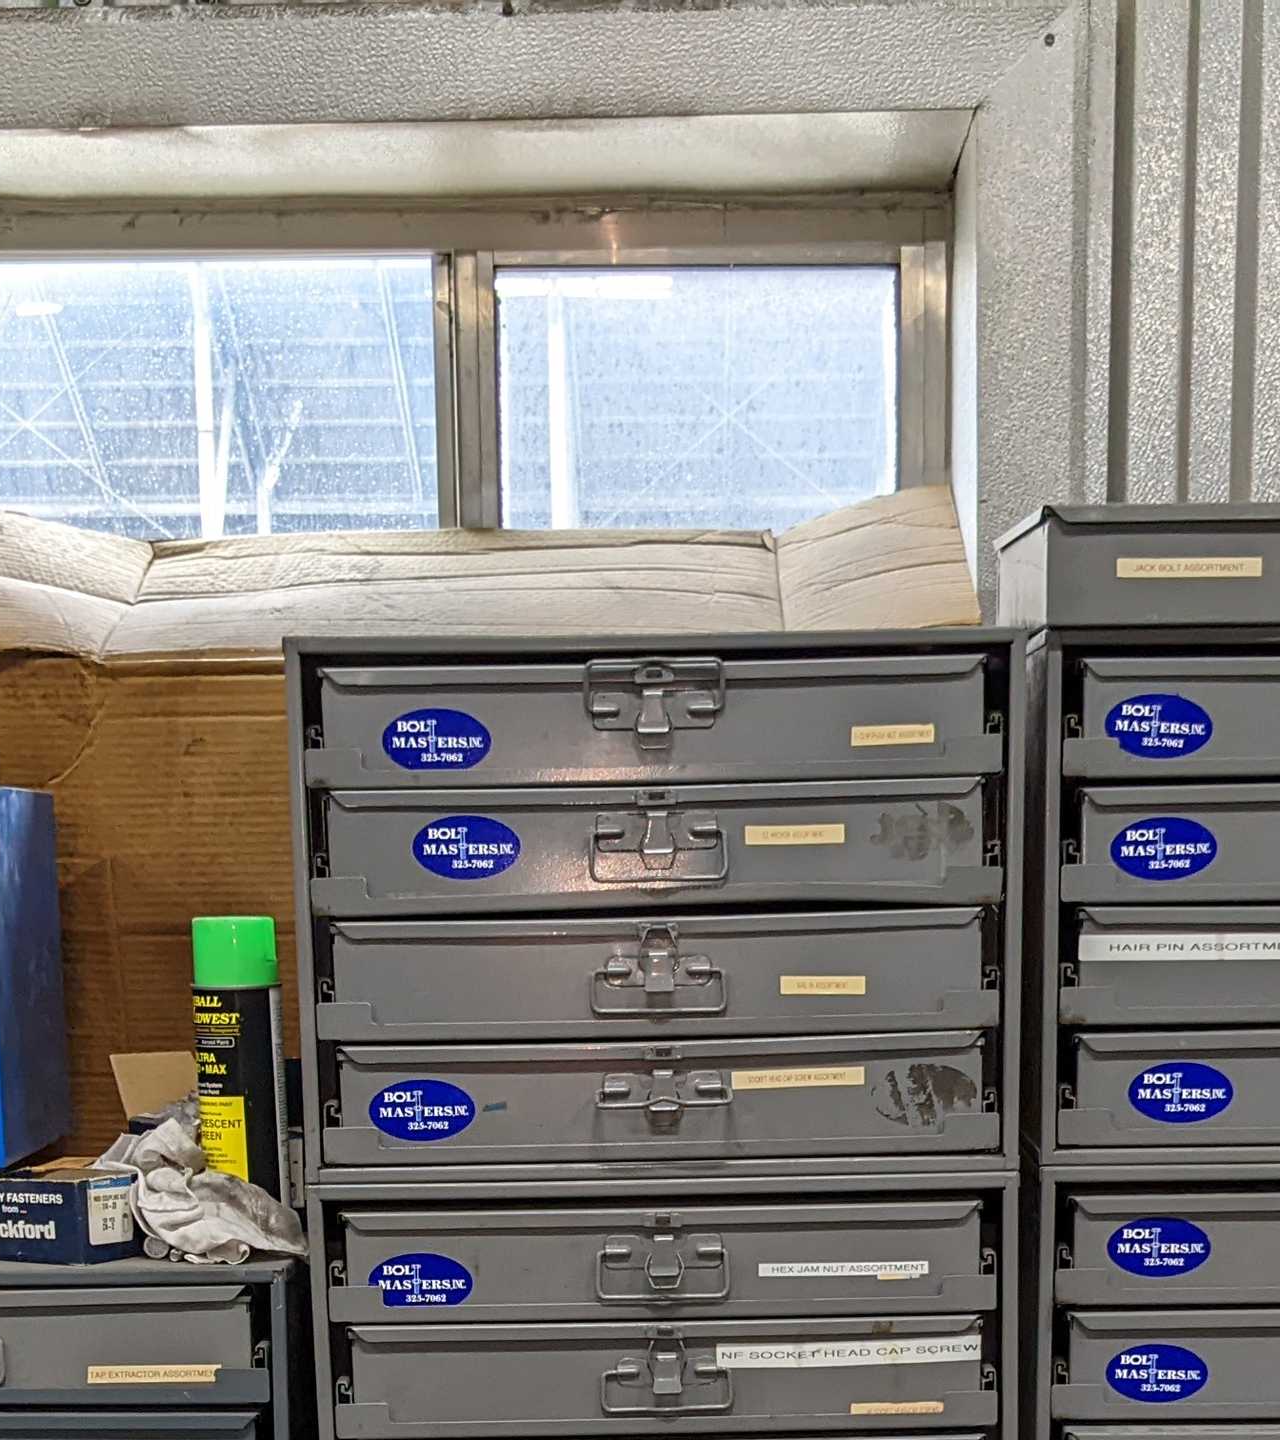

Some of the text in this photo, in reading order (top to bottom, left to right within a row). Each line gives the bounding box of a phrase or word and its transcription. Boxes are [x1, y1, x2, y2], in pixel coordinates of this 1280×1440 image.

[421, 753, 463, 762] 325-7062
[1109, 943, 1150, 953] HAIR
[1156, 943, 1184, 952] PIN
[6, 1192, 64, 1205] FASTENERS
[771, 1263, 926, 1274] HEX JAM NUT ASSORTMENT
[721, 1343, 979, 1361] NF SOCKET HEAD CAP SCREW
[109, 1370, 161, 1379] EXTRACTOR
